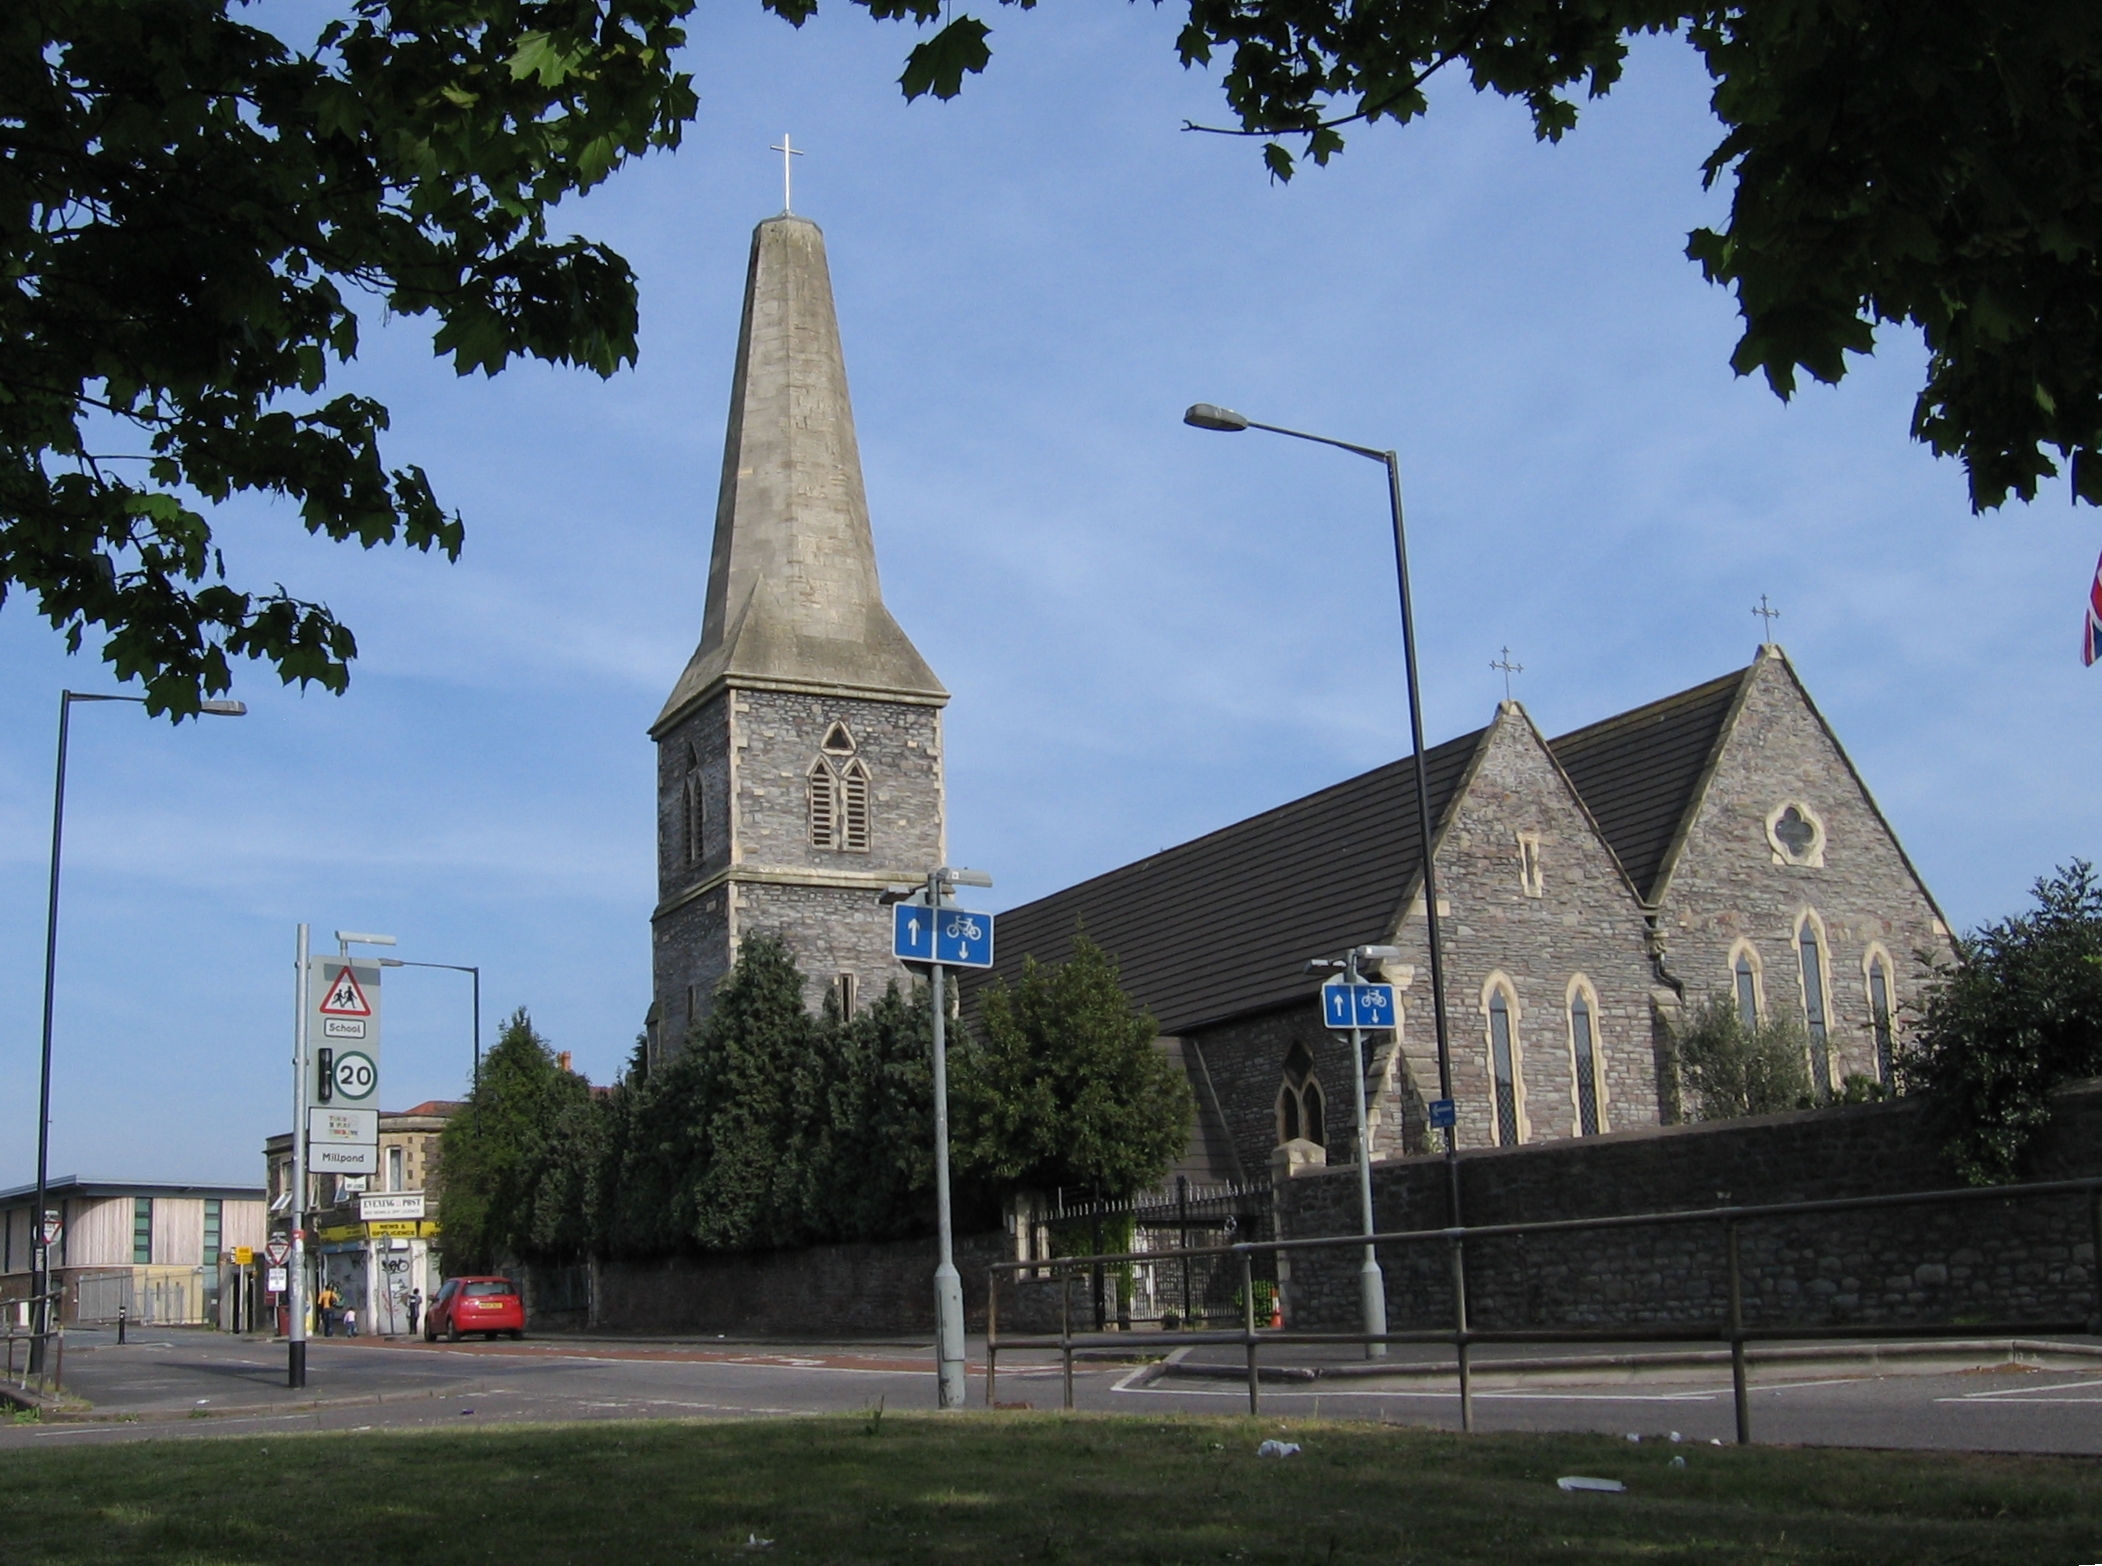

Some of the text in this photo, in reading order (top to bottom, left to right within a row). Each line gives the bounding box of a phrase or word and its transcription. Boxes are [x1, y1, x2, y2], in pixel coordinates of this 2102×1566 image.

[328, 1023, 361, 1034] School
[340, 1065, 371, 1086] 20
[322, 1152, 365, 1163] Millpond
[363, 1198, 421, 1208] EVENING POST
